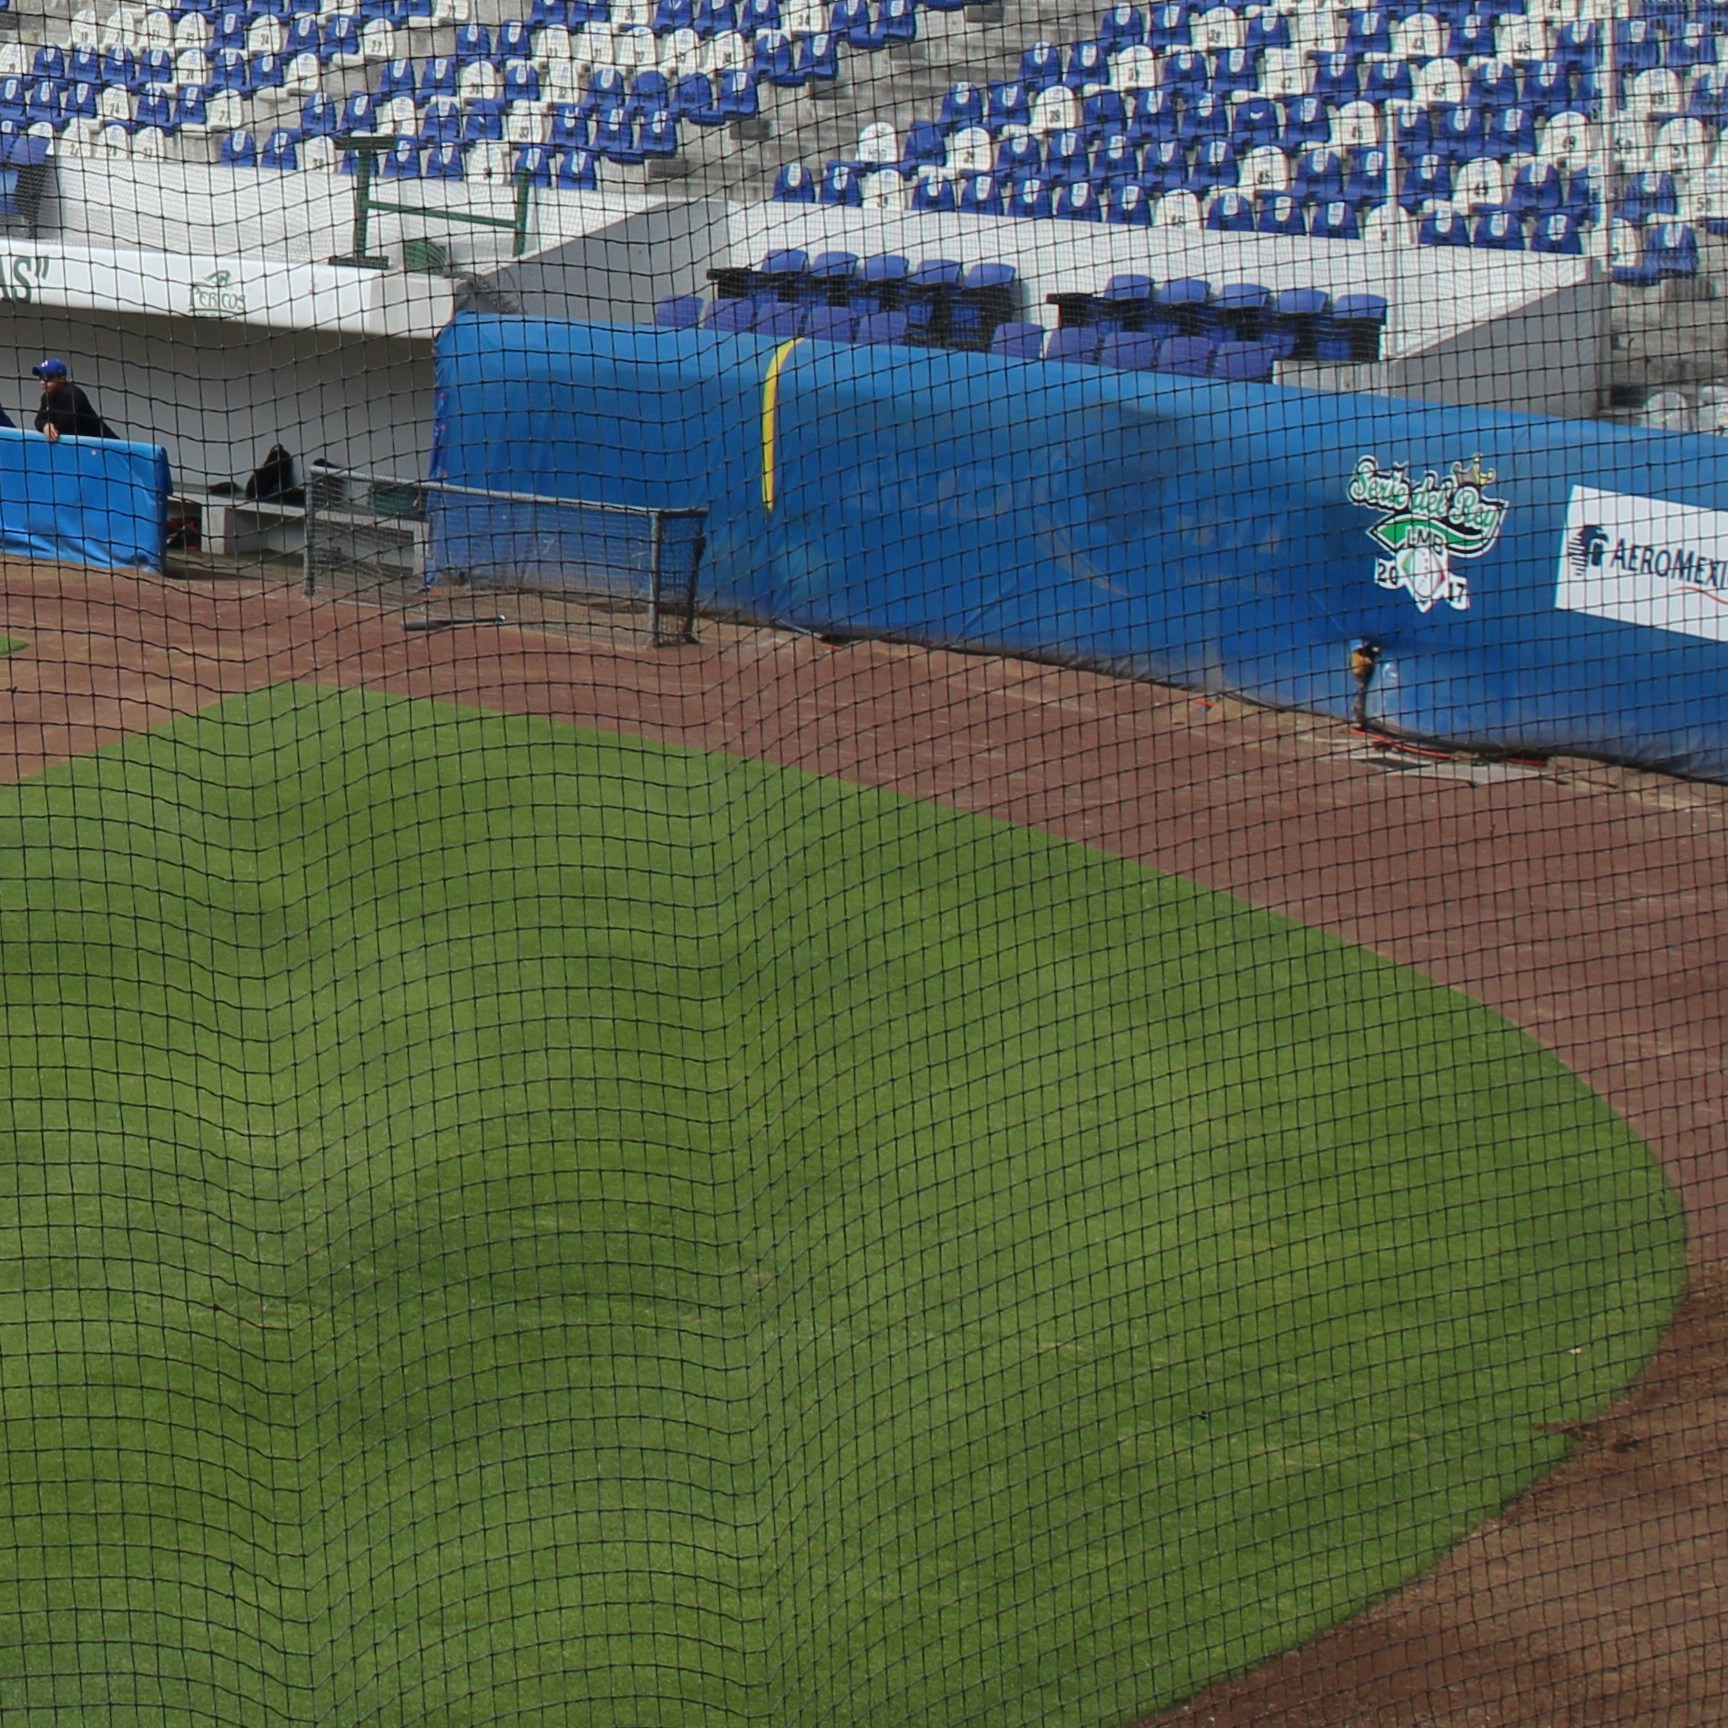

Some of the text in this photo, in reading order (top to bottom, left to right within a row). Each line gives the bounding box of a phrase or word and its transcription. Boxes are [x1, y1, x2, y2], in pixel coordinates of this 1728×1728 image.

[189, 285, 247, 311] PERICOS
[1350, 462, 1501, 535] Serie del Rey
[1407, 527, 1444, 555] LMB
